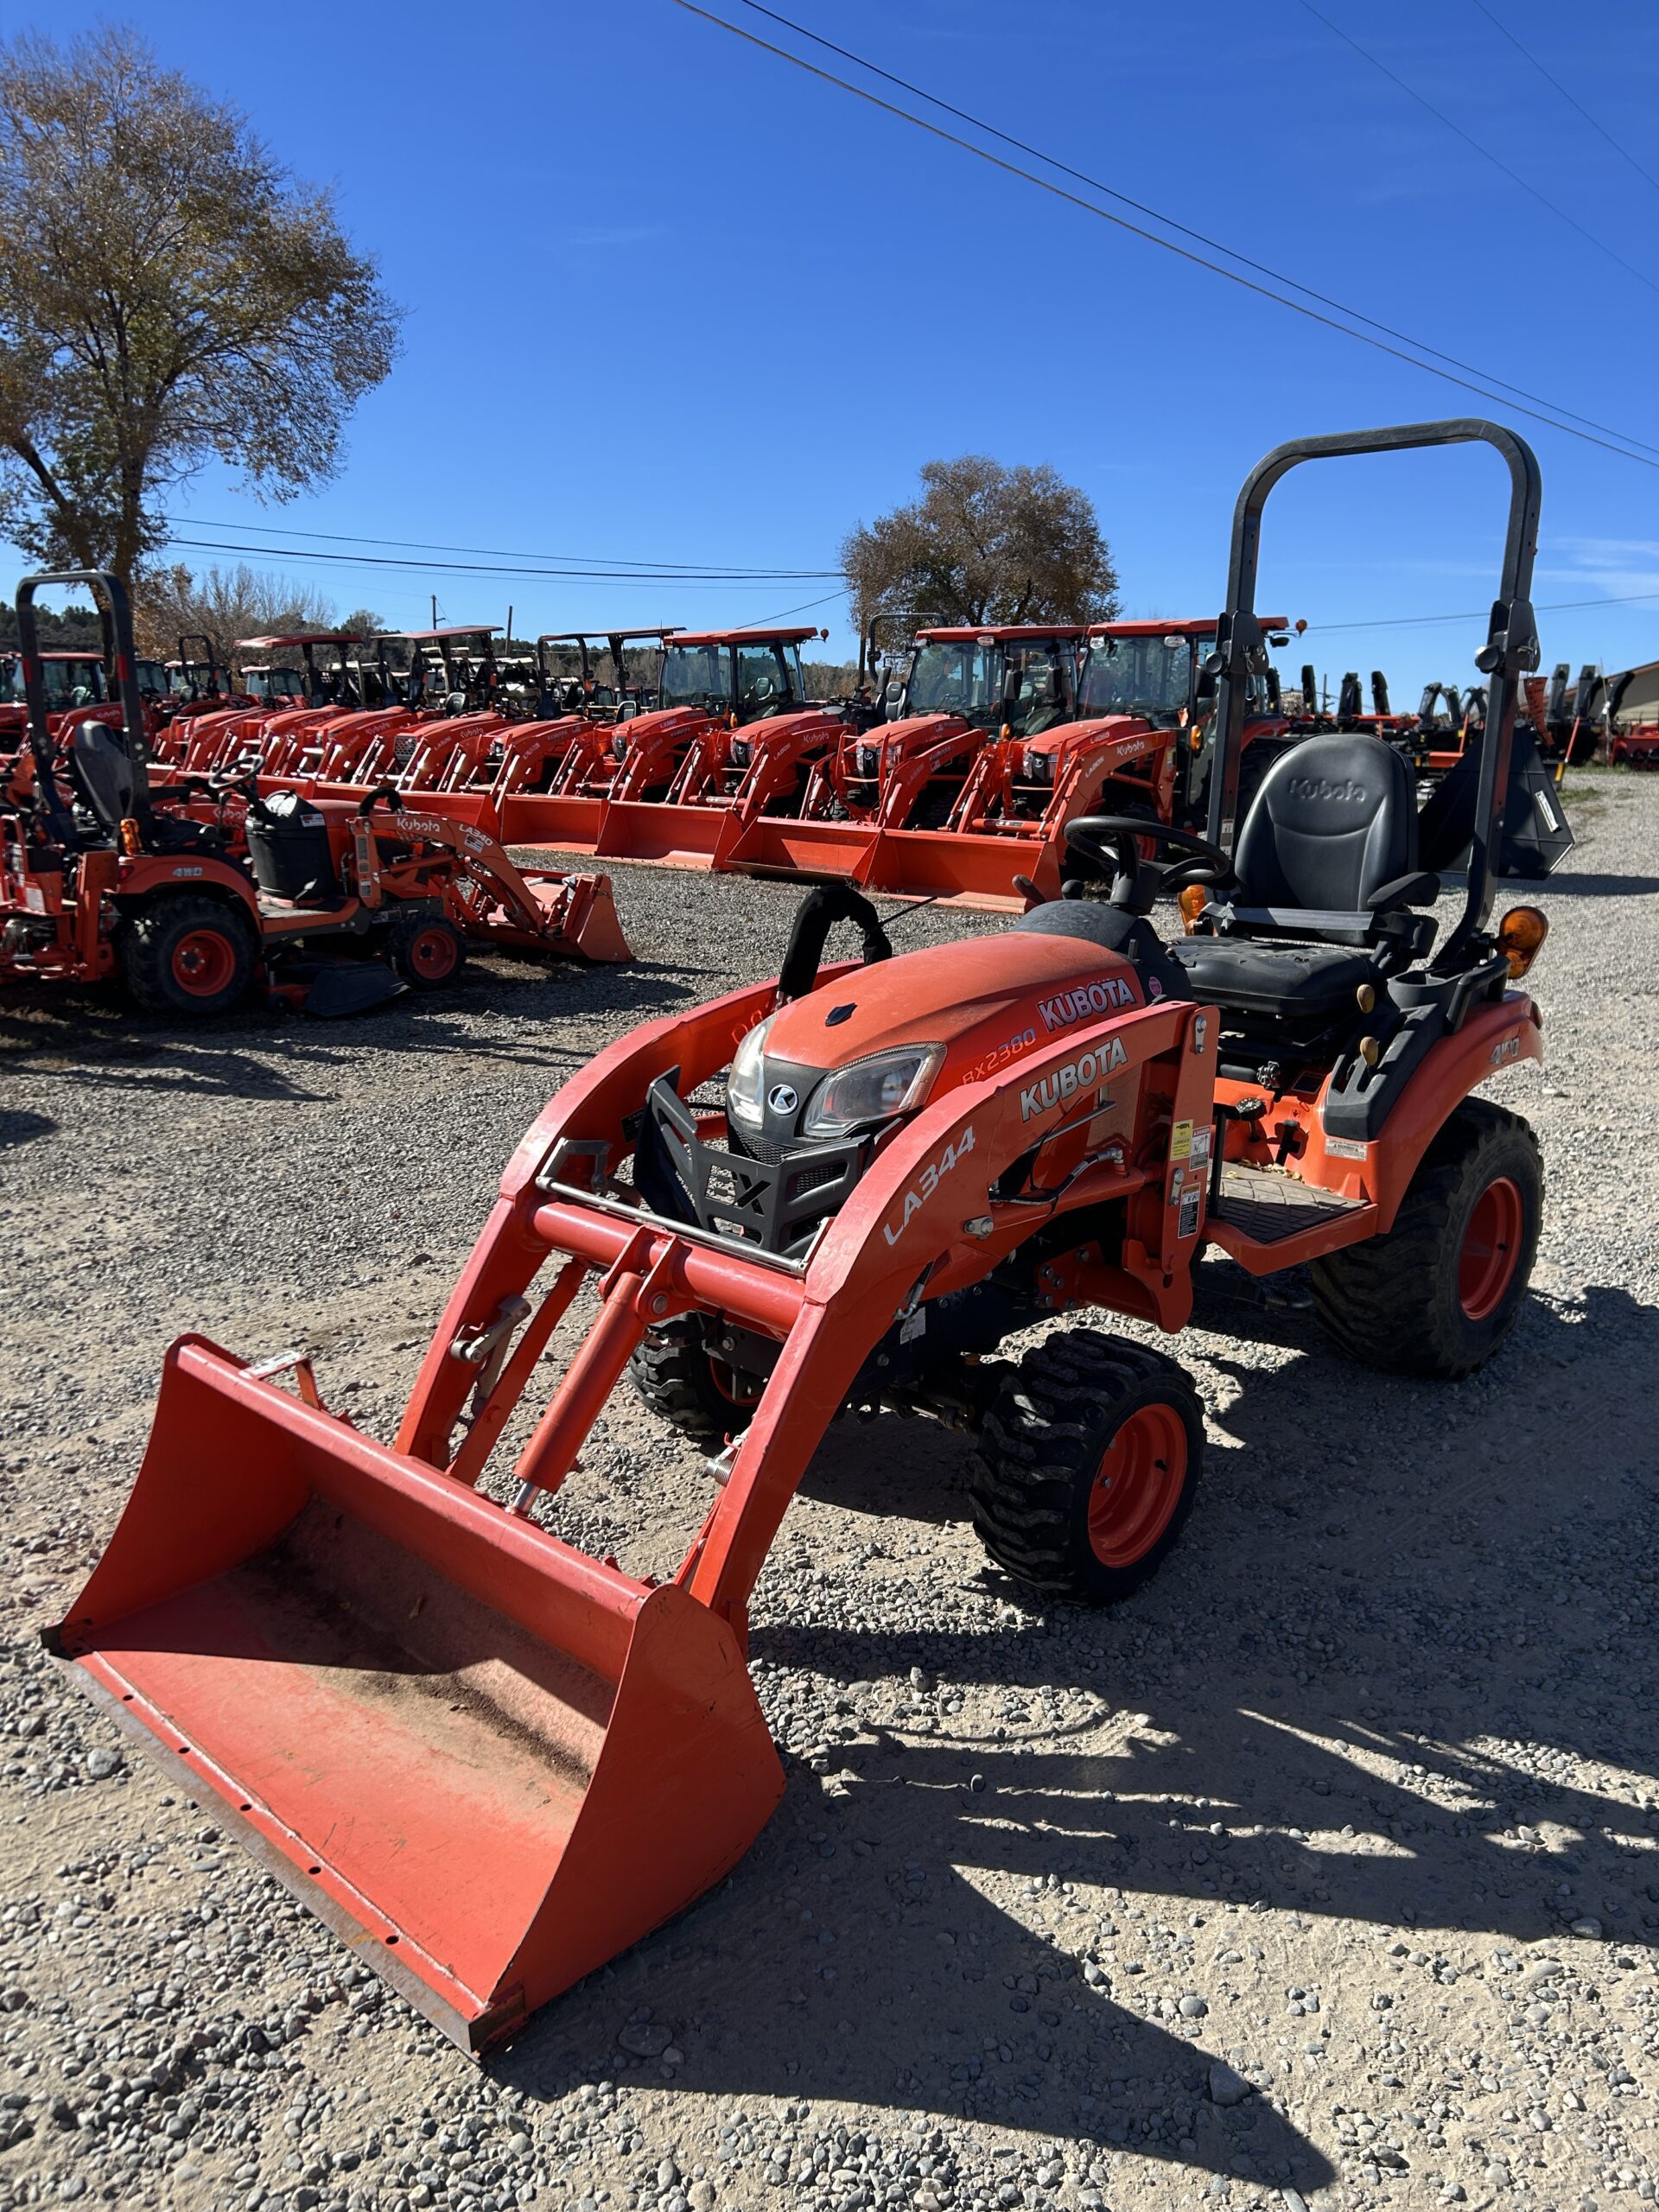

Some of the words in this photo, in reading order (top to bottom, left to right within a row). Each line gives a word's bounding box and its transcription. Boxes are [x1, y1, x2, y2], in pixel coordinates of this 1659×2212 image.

[802, 730, 830, 743] Kubota
[1116, 740, 1145, 756] Kubota
[1288, 779, 1367, 803] Kubota
[397, 817, 441, 832] Kubota
[458, 823, 493, 847] LA340
[172, 866, 203, 877] 4WD
[1038, 977, 1136, 1032] KUBOTA
[1020, 1037, 1128, 1122] KUBOTA
[883, 1125, 976, 1246] LA344
